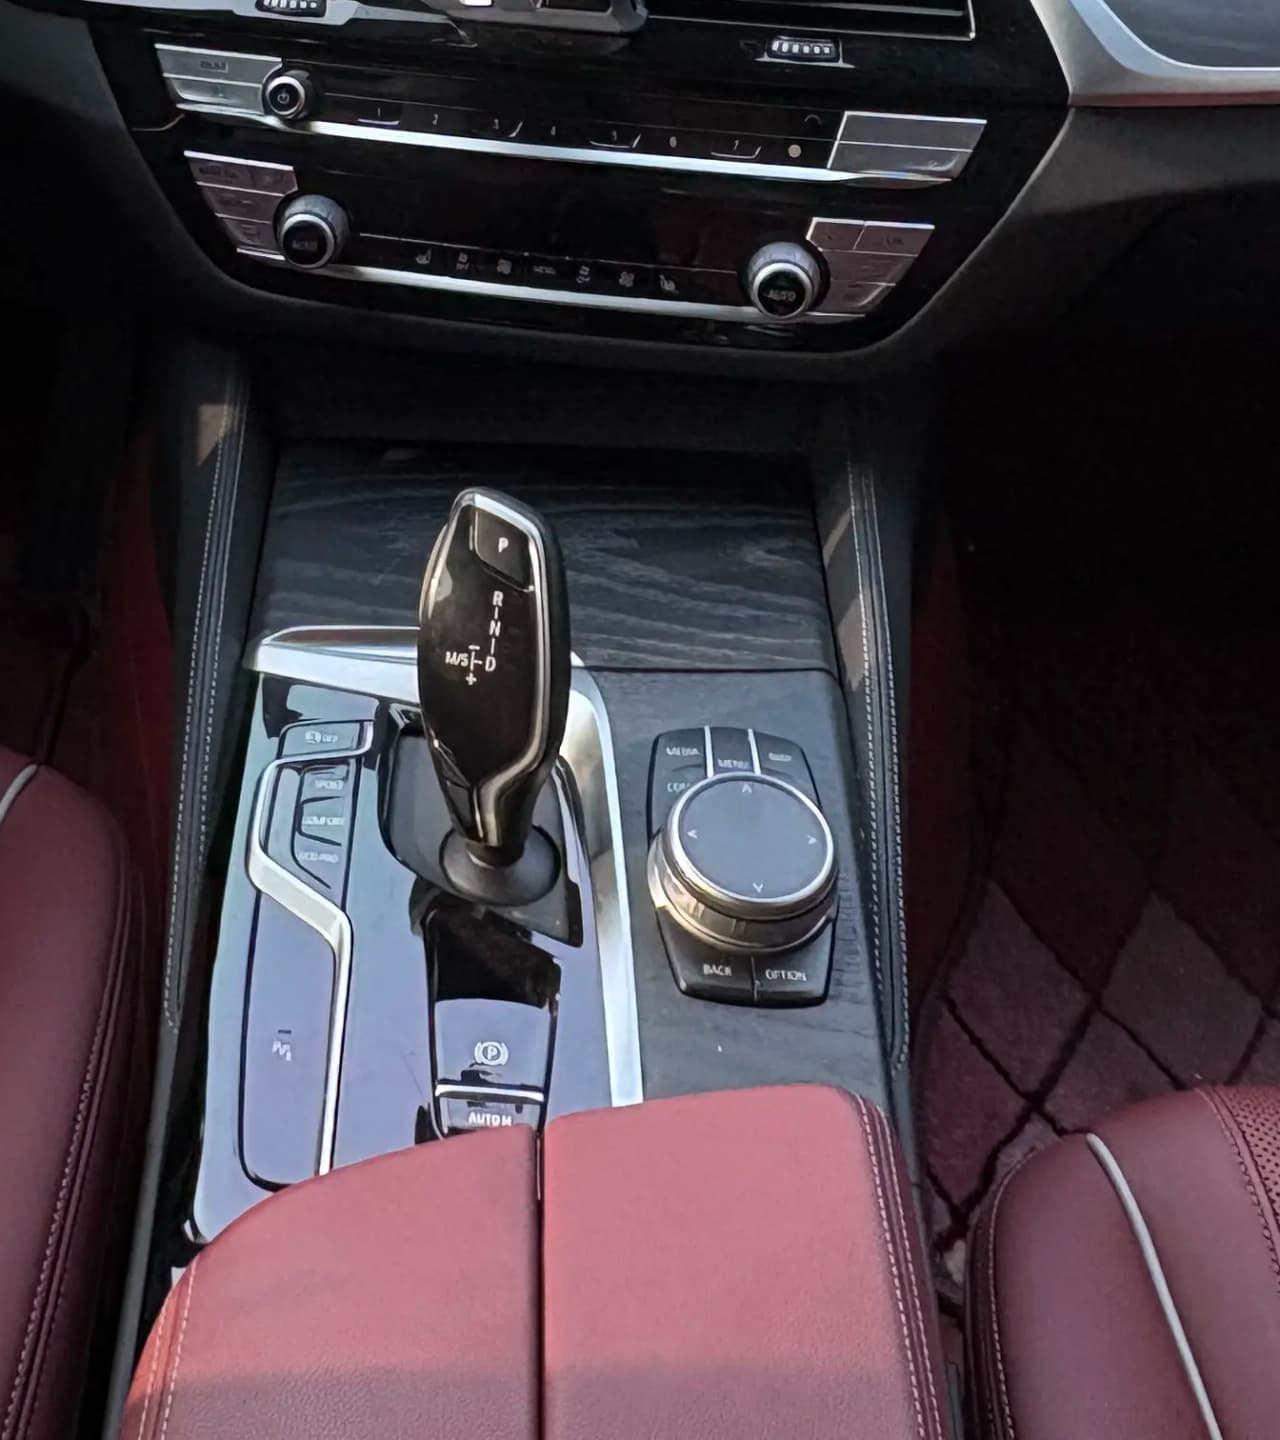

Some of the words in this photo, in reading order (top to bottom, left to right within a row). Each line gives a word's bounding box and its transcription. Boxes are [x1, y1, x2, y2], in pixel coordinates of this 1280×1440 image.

[497, 537, 510, 553] P
[492, 591, 504, 607] R
[489, 620, 502, 637] N
[445, 651, 469, 667] M/S
[485, 656, 497, 672] D
[703, 963, 732, 977] BACK
[765, 968, 807, 982] OPTION
[468, 1111, 499, 1127] AUTO
